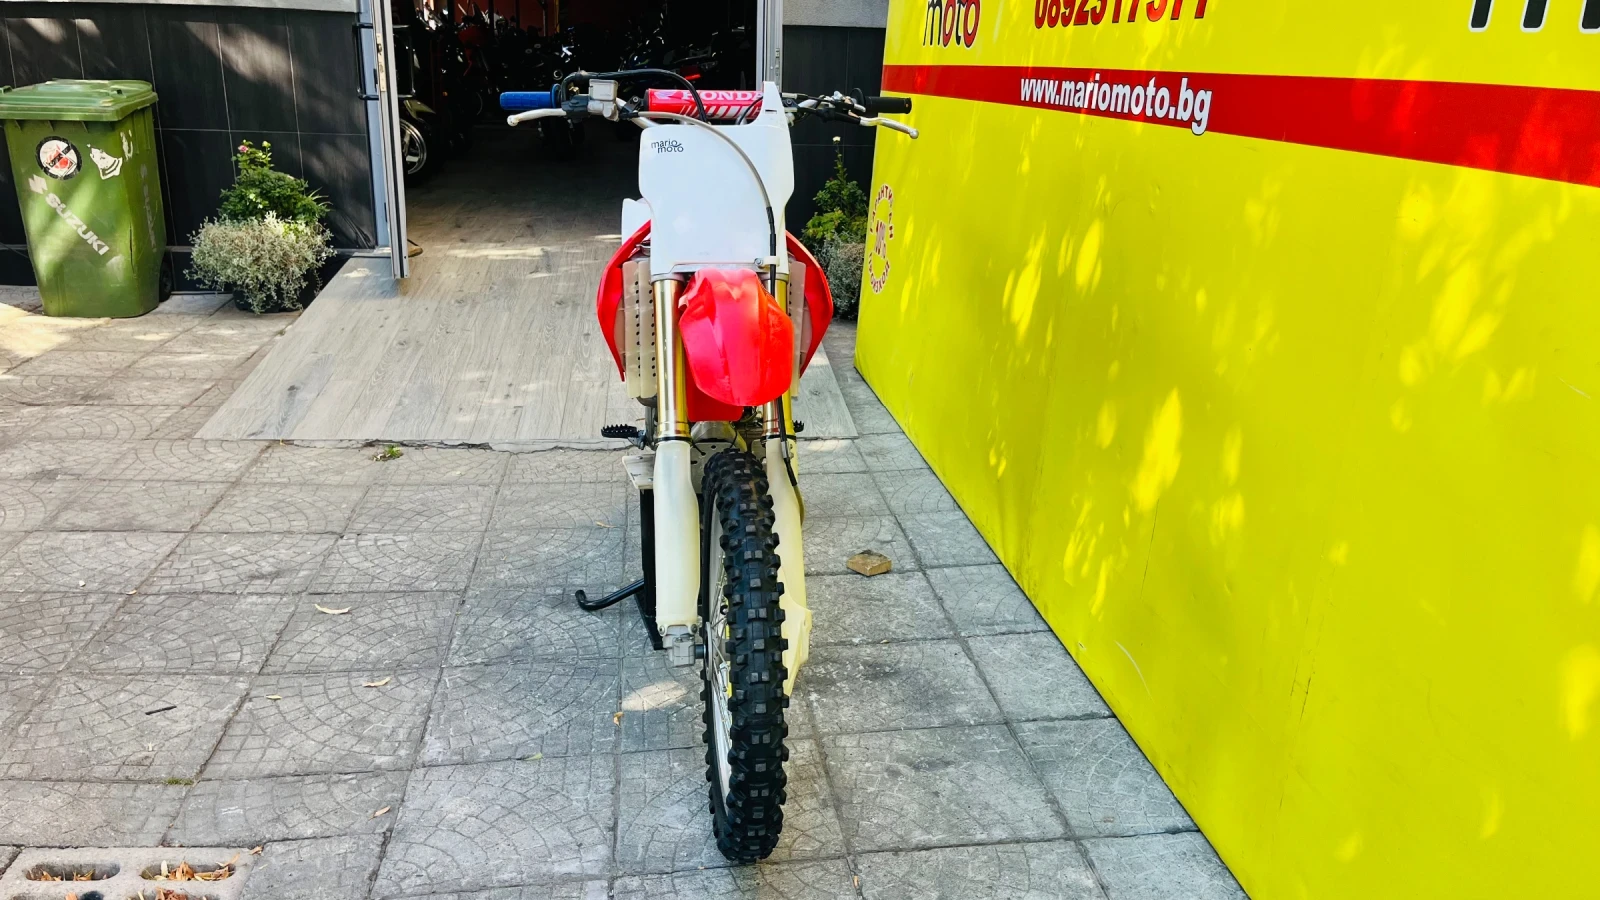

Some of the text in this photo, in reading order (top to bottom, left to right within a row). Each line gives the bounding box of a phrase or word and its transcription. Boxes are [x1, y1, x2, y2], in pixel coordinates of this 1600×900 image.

[923, 0, 981, 48] moto
[1020, 73, 1212, 136] www.mariomoto.bg
[651, 139, 678, 148] mario
[657, 144, 684, 153] moto
[45, 192, 110, 256] SUZUKI
